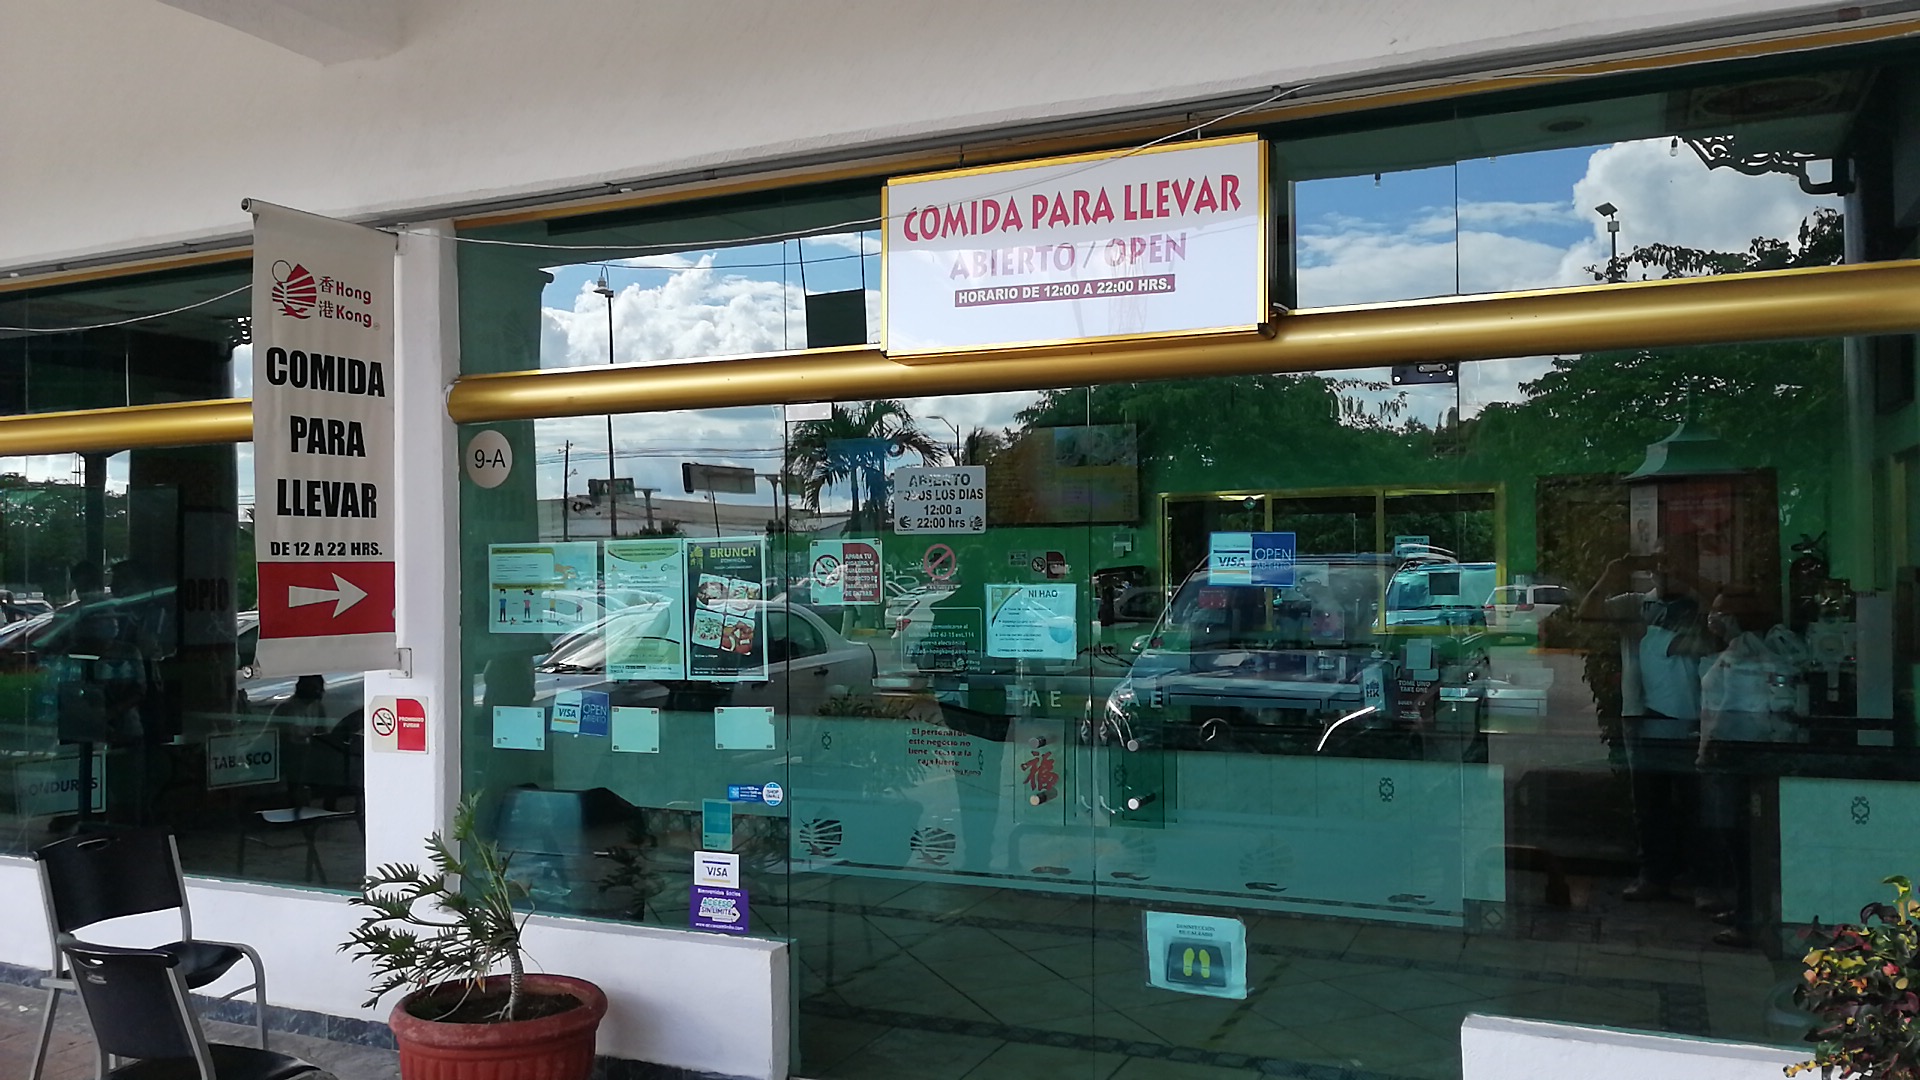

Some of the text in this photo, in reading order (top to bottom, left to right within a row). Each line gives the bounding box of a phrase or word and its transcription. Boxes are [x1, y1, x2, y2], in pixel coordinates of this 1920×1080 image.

[904, 174, 1242, 242] COMIDA PARA LLEVAR
[950, 242, 1076, 281] ABIERTO
[1103, 231, 1188, 269] OPEN
[318, 275, 335, 294] 香
[336, 281, 372, 306] Hong
[958, 276, 1173, 304] HORARIO DE 12:00 A 22:00 HRS.
[318, 300, 335, 318] 港
[335, 308, 373, 329] Kong
[265, 346, 386, 398] COMIDA
[289, 415, 367, 458] PARA
[474, 448, 506, 469] 9-A
[276, 478, 378, 519] LLEVAR
[935, 489, 956, 501] LOS
[958, 488, 984, 500] DIAS
[923, 504, 962, 516] 12:00 a
[917, 517, 966, 529] 22:00 hrs
[269, 541, 383, 556] DE 12 A 22 HRS.
[709, 547, 756, 558] BRUNCH
[1218, 547, 1293, 567] VISA OPEN
[1028, 589, 1059, 599] NI HAO
[559, 704, 607, 717] VISA OPEN
[926, 739, 957, 747] negocio
[212, 750, 273, 770] TABASCO
[1020, 751, 1058, 790] 福
[706, 866, 728, 877] VISA
